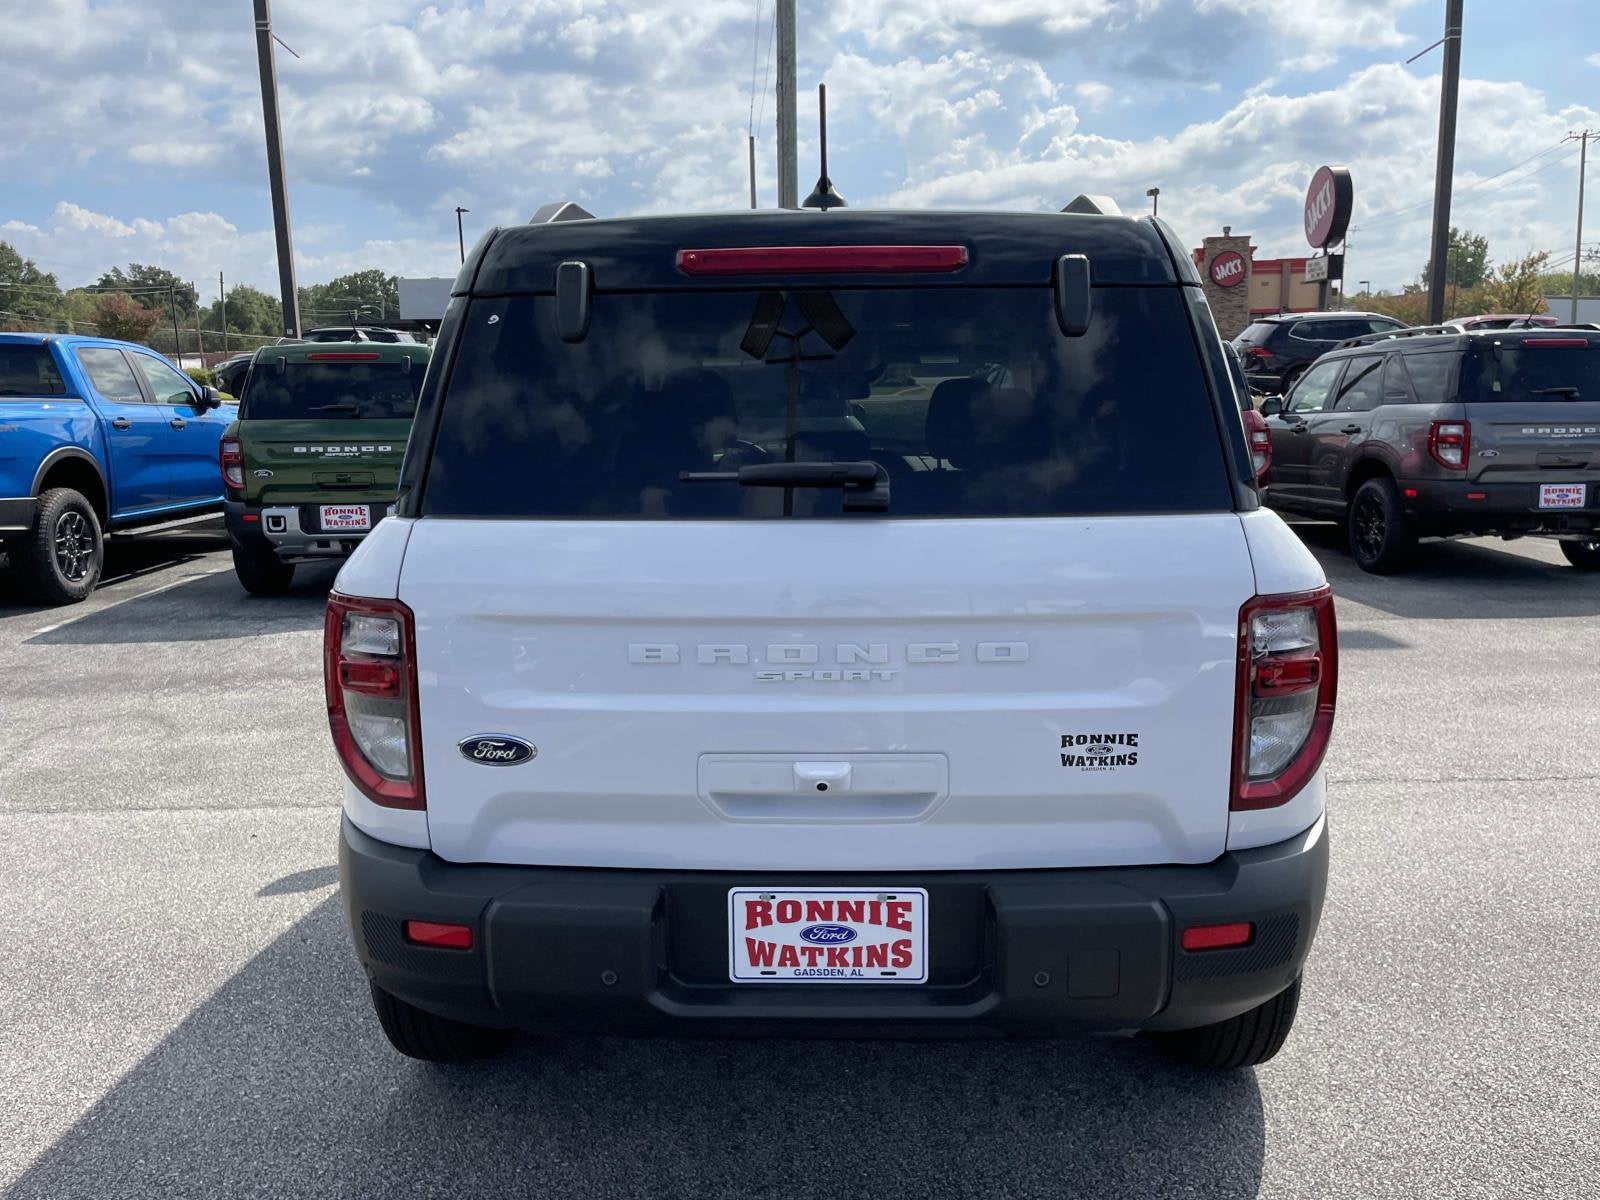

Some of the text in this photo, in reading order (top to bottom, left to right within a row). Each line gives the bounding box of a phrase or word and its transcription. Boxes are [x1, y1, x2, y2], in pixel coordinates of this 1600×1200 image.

[293, 445, 392, 453] BRONCO
[1544, 497, 1582, 505] WATKINS
[325, 508, 366, 516] RONNIE
[325, 518, 367, 526] WATKINS
[628, 641, 1030, 664] BRONCO
[756, 669, 899, 682] SPORT
[1061, 733, 1138, 748] RONNIE
[474, 740, 517, 760] Ford
[1061, 752, 1138, 766] WATKINS
[745, 900, 912, 932] RONNIE
[810, 926, 849, 941] Ford
[745, 937, 912, 968] WATKINS
[794, 968, 864, 977] GADSDEN, AL
